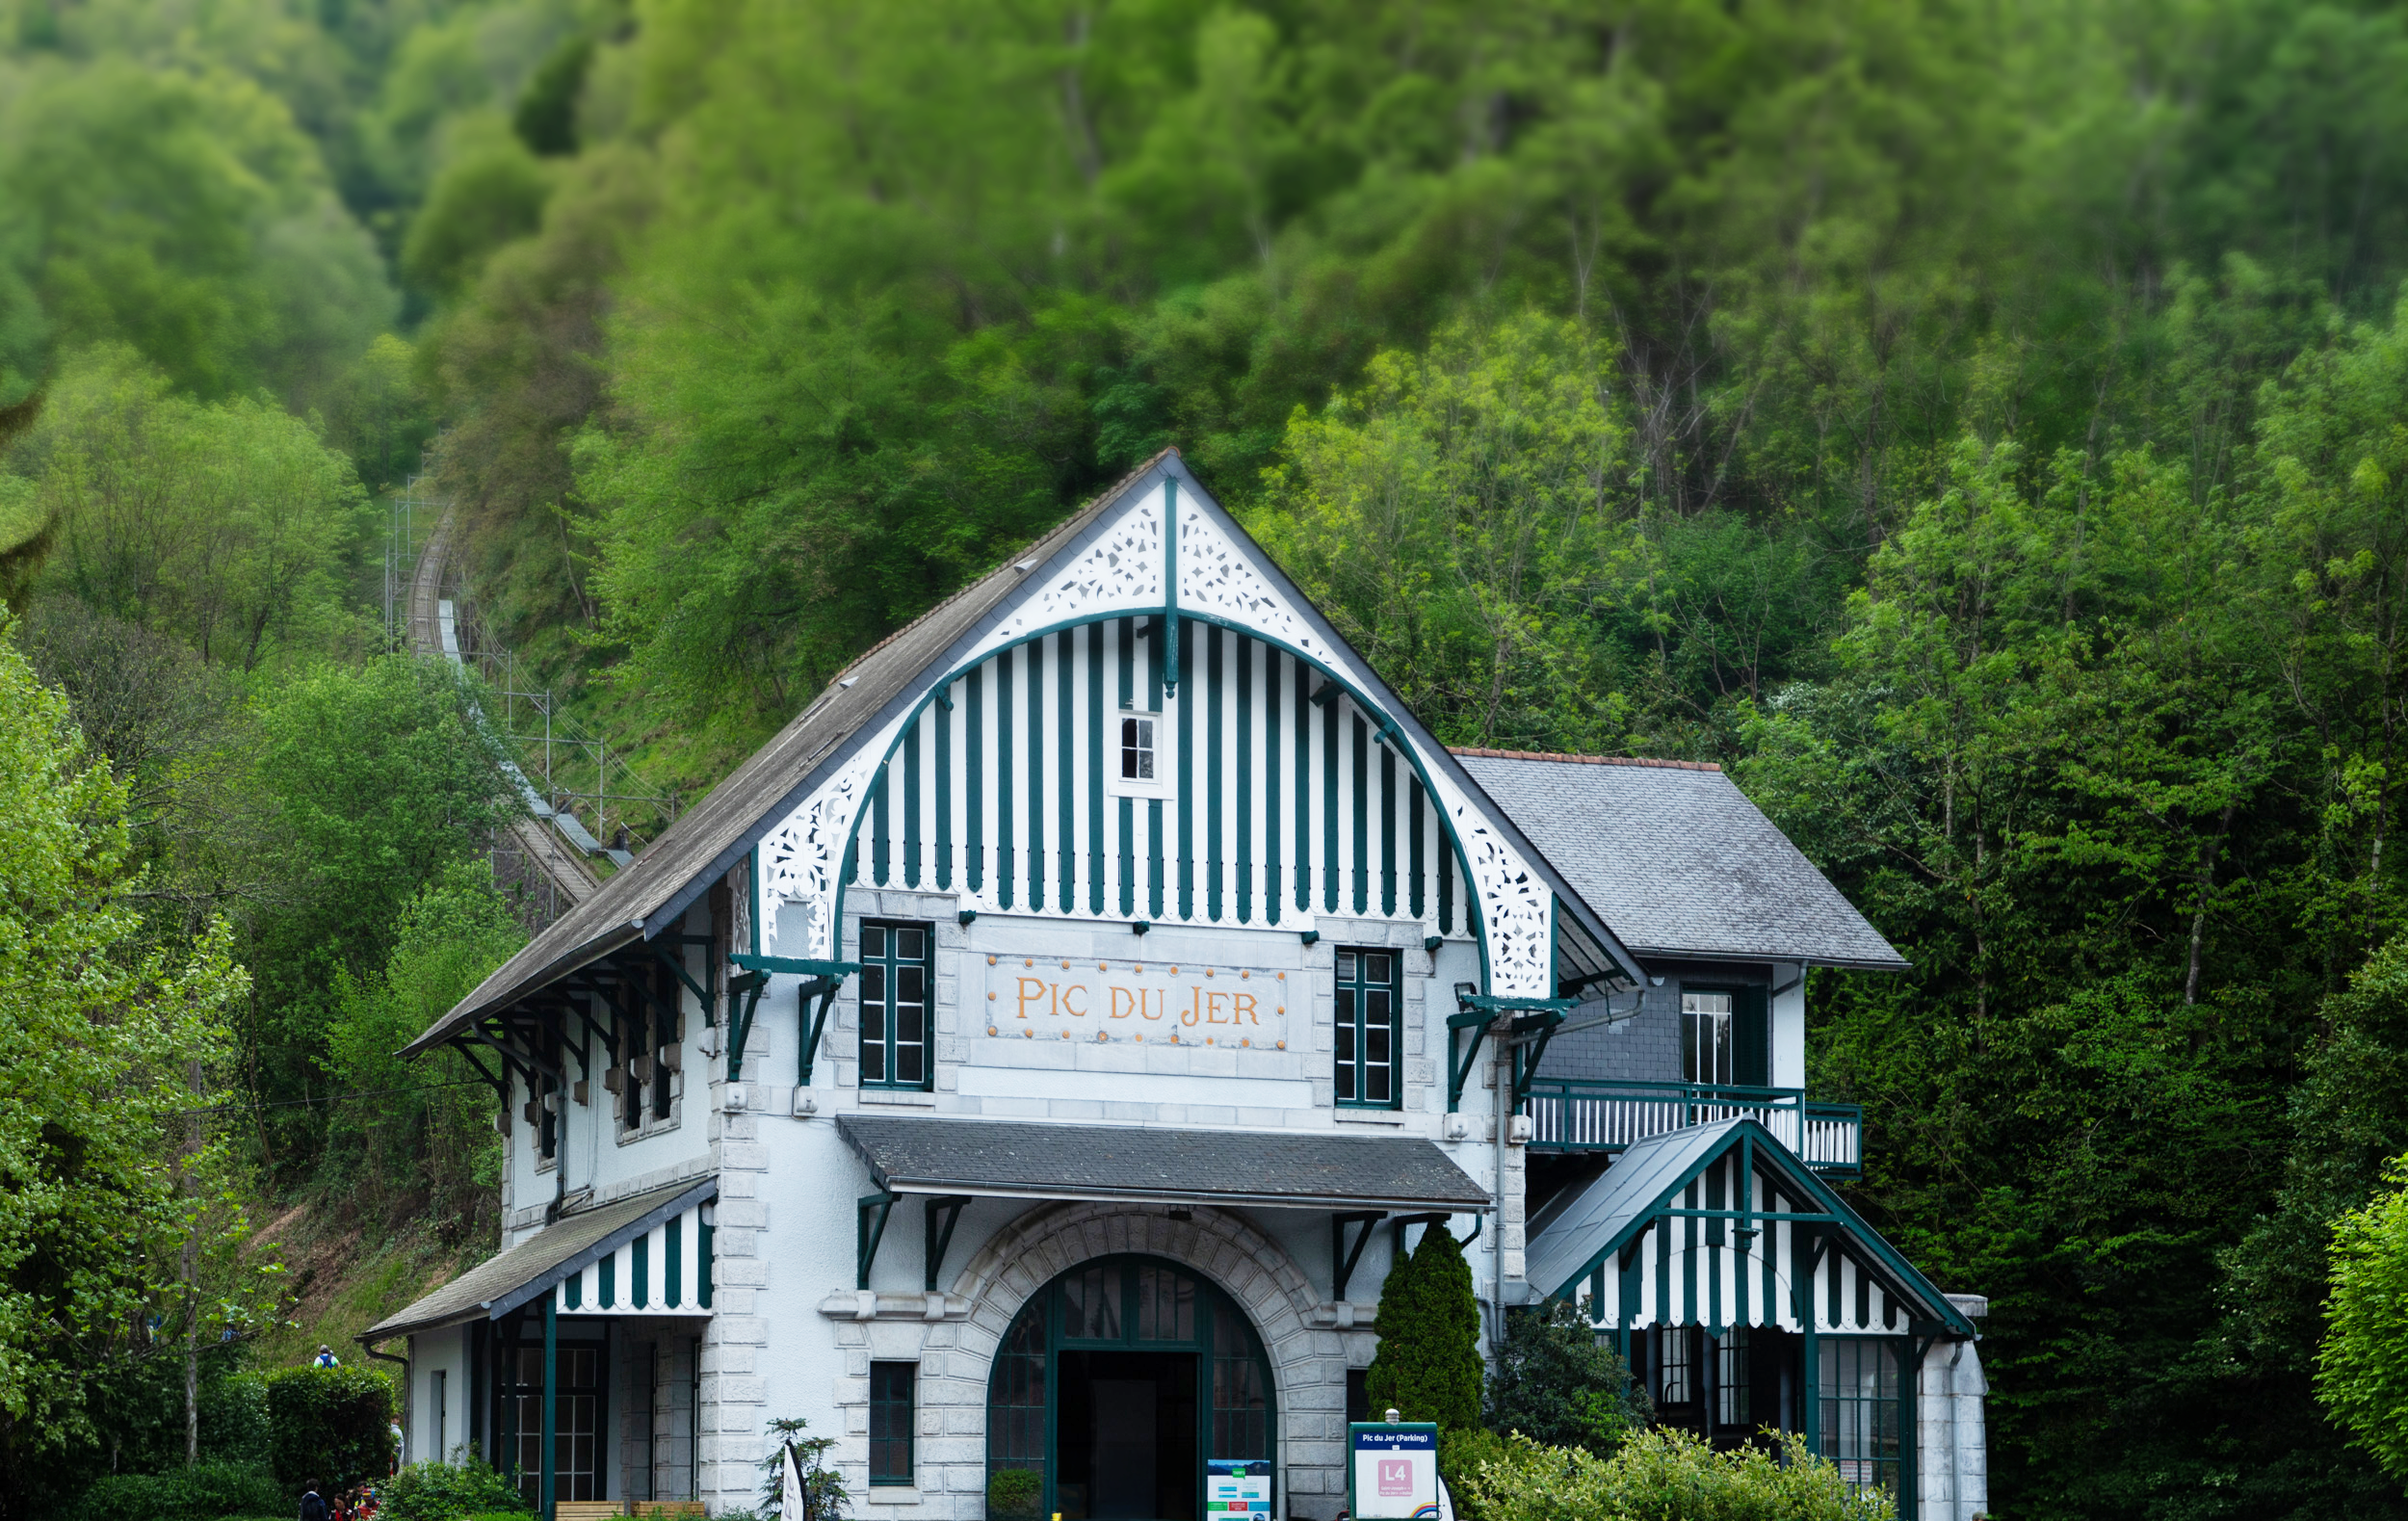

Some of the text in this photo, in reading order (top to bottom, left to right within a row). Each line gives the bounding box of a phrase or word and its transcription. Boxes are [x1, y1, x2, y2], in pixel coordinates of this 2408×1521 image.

[1016, 977, 1260, 1027] PIC DU JER
[1396, 1434, 1427, 1443] (Parking)
[1385, 1464, 1406, 1482] L4
